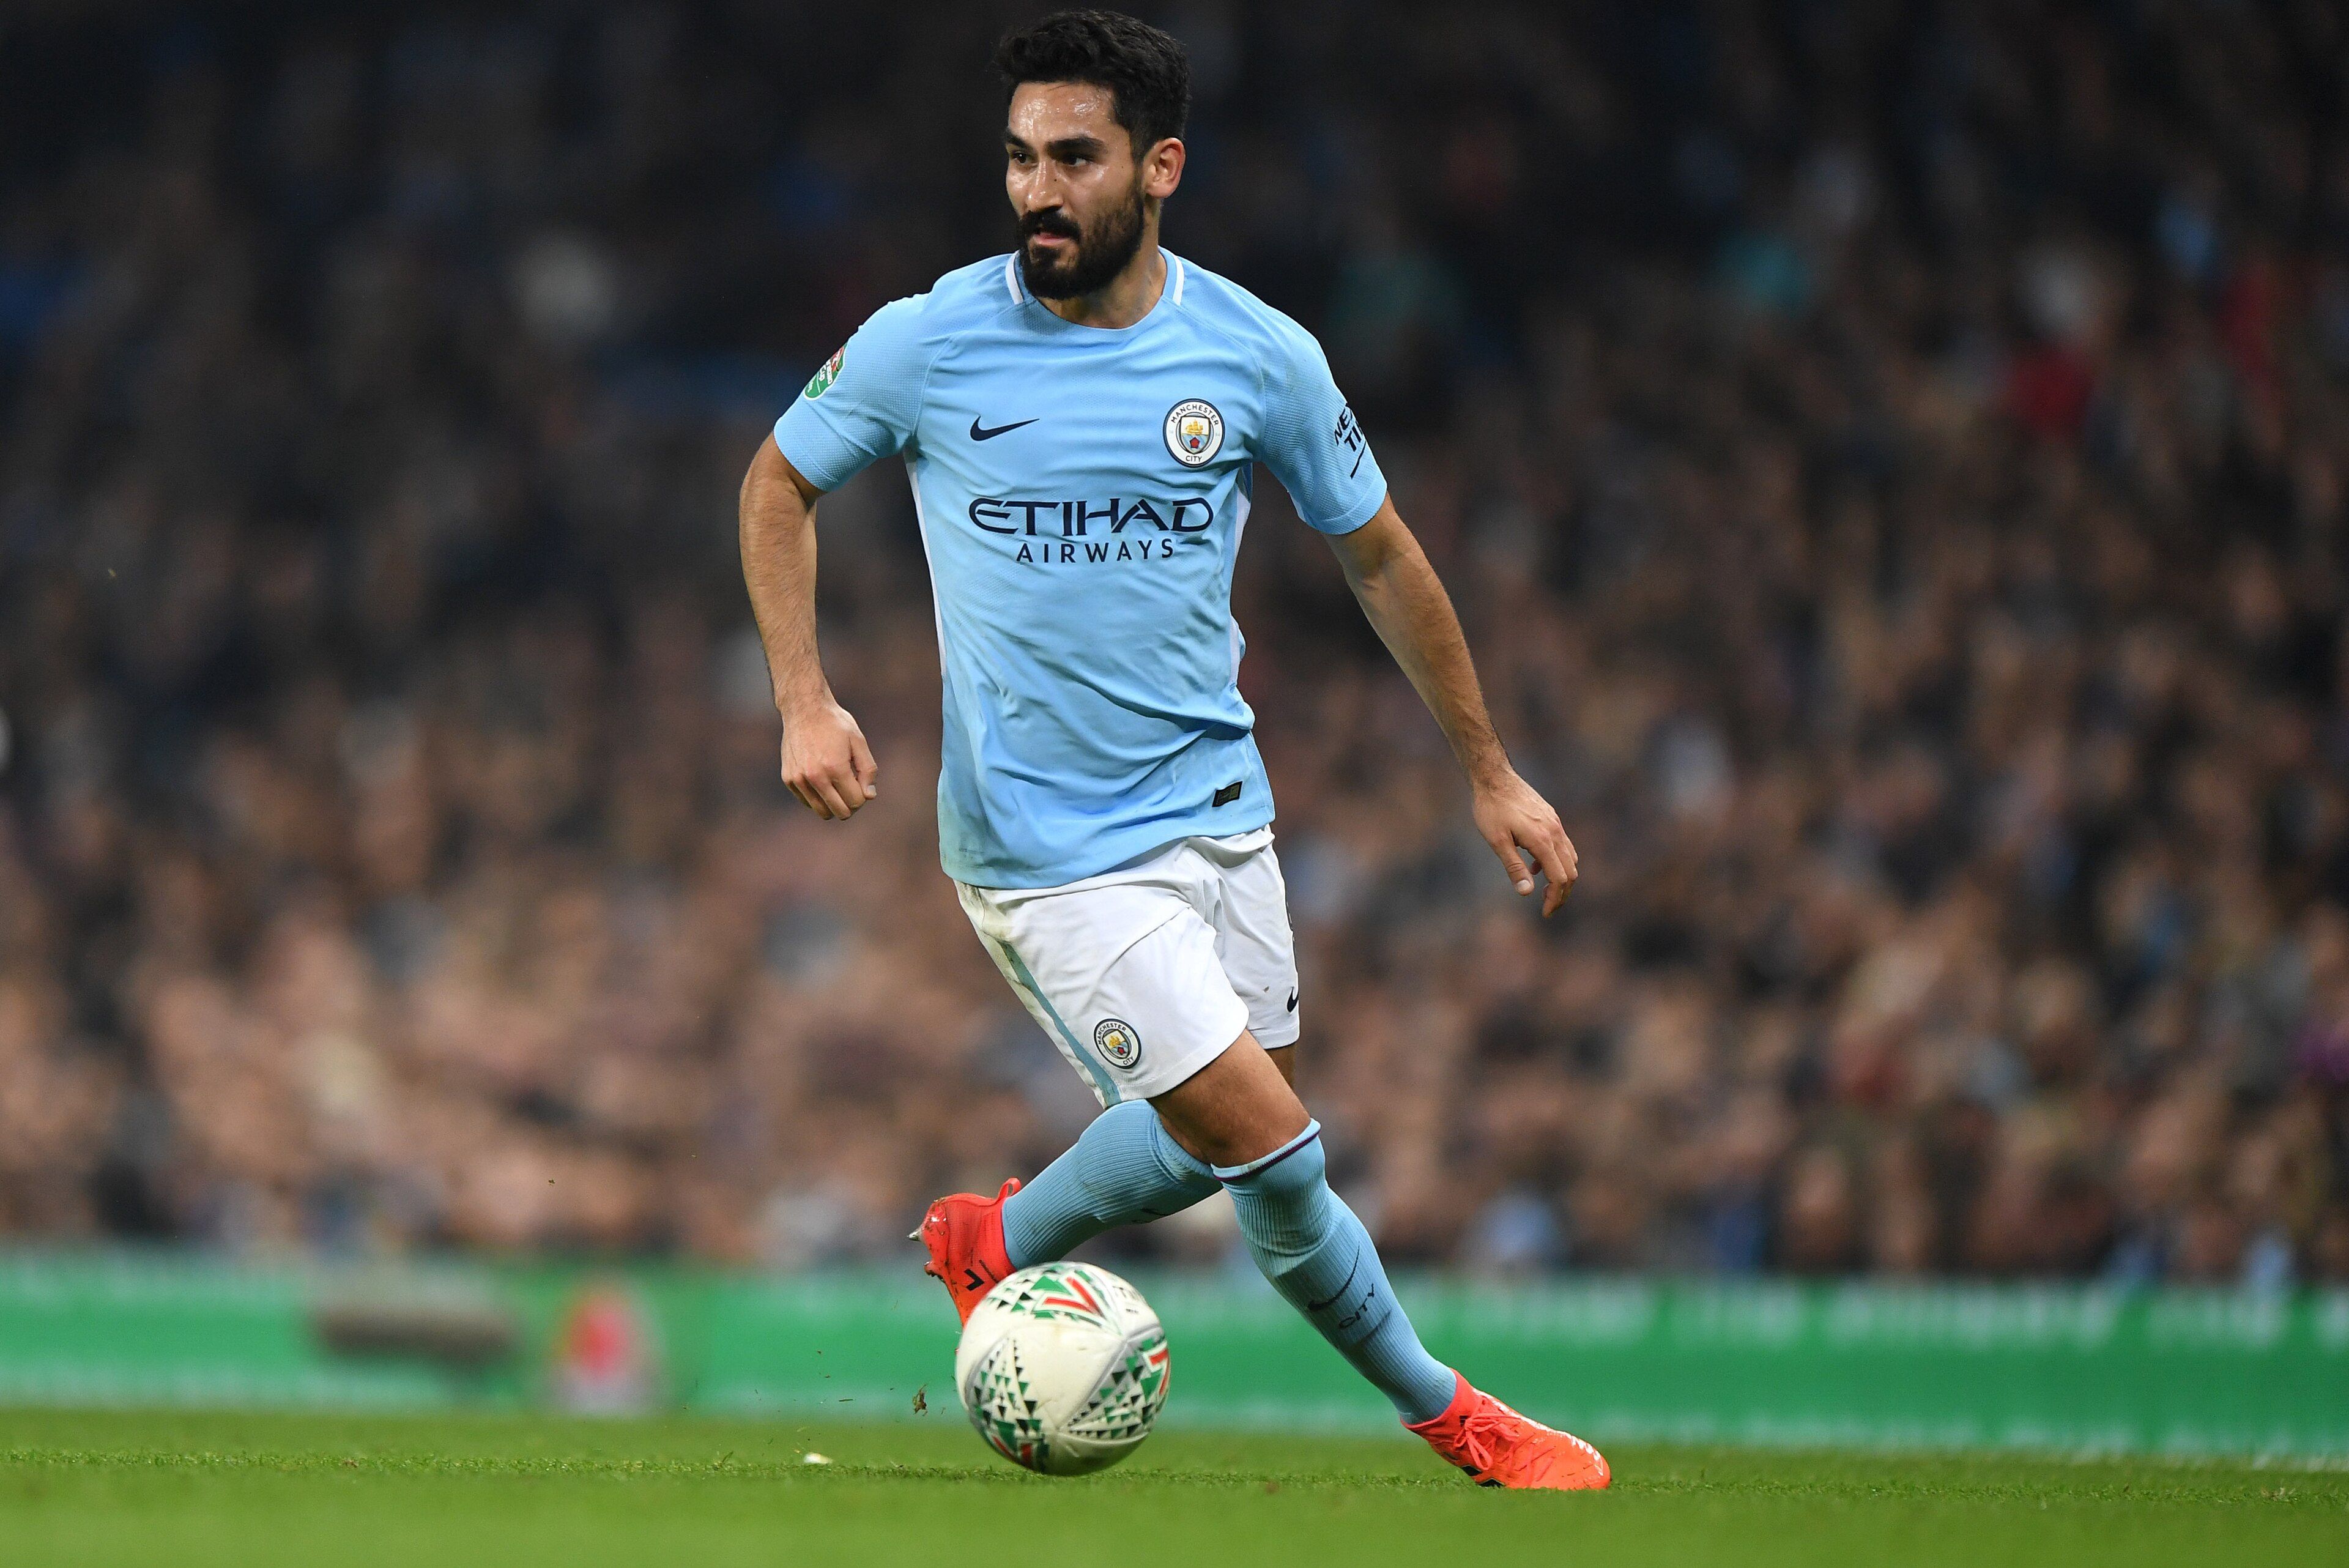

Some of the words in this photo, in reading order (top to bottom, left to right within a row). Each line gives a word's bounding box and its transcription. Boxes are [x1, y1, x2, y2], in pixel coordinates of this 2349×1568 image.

[1171, 404, 1219, 426] MANCHESTER
[968, 497, 1214, 537] ETIHAD
[1016, 538, 1174, 563] AIRWAYS
[1097, 1022, 1126, 1045] MANCHESTER
[1123, 1056, 1134, 1065] CITY
[1339, 1283, 1375, 1329] CITY
